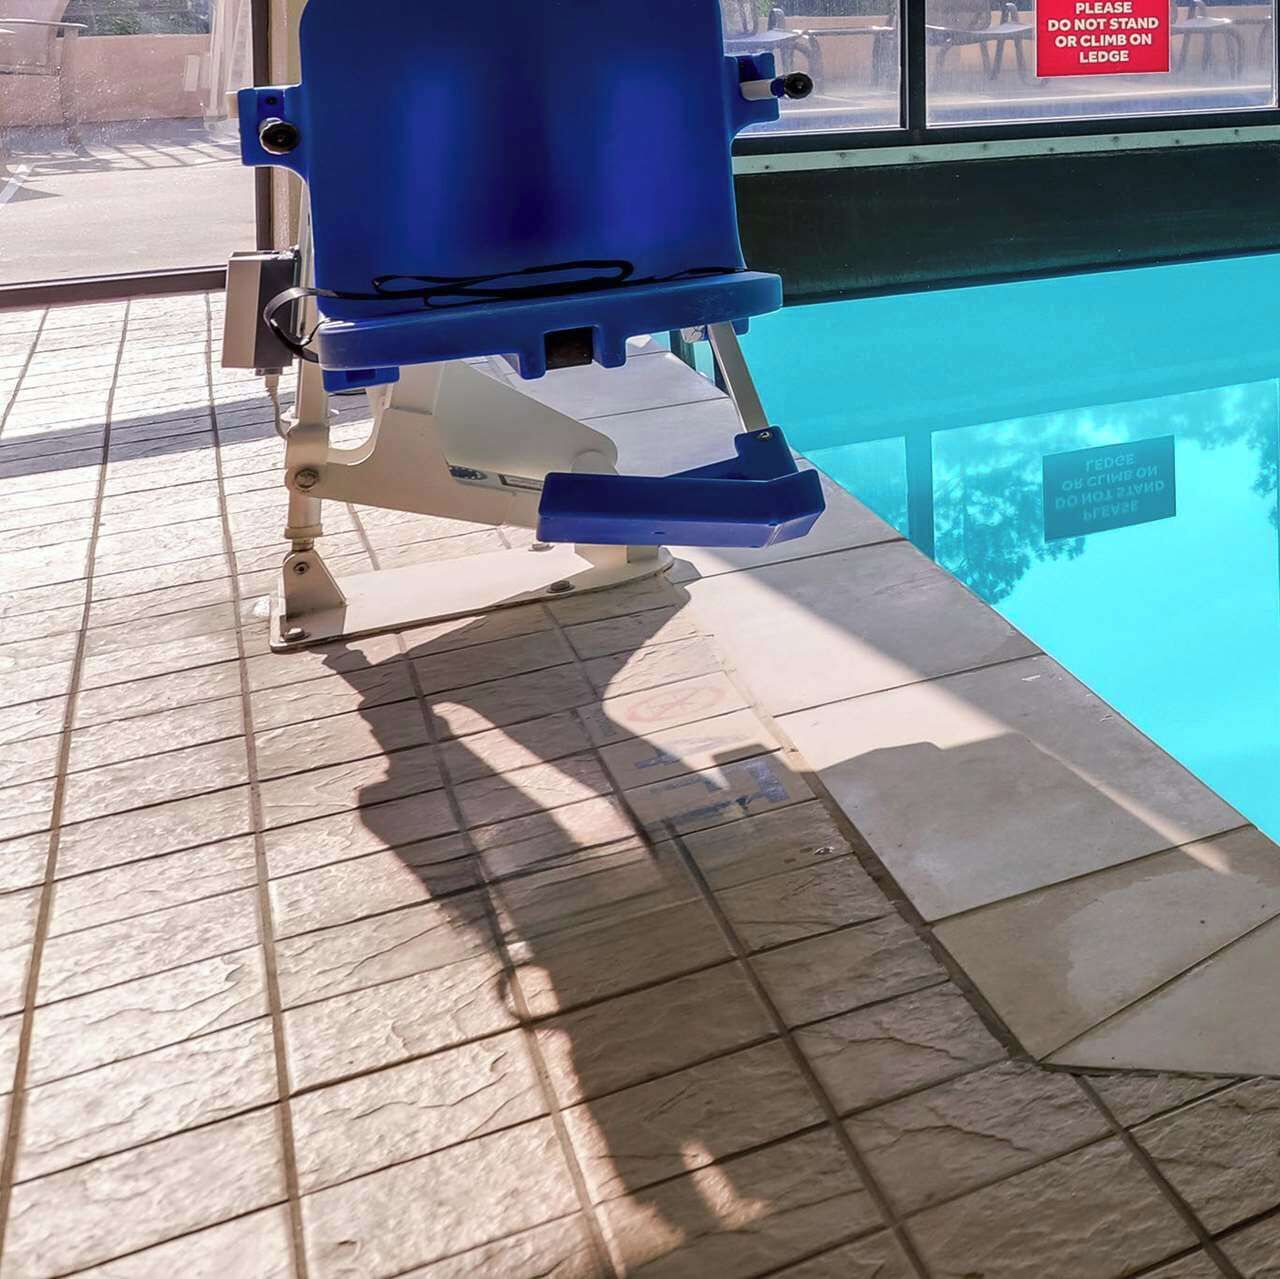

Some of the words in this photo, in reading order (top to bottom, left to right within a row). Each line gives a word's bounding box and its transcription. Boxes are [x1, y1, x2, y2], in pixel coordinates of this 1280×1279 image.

[1075, 2, 1133, 15] PLEASE
[1048, 19, 1071, 32] DO
[1074, 18, 1107, 31] NOT
[1109, 17, 1159, 30] STAND
[1055, 36, 1077, 48] OR
[1080, 35, 1127, 47] CLIMB
[1129, 33, 1152, 45] ON
[1079, 51, 1129, 64] LEDGE
